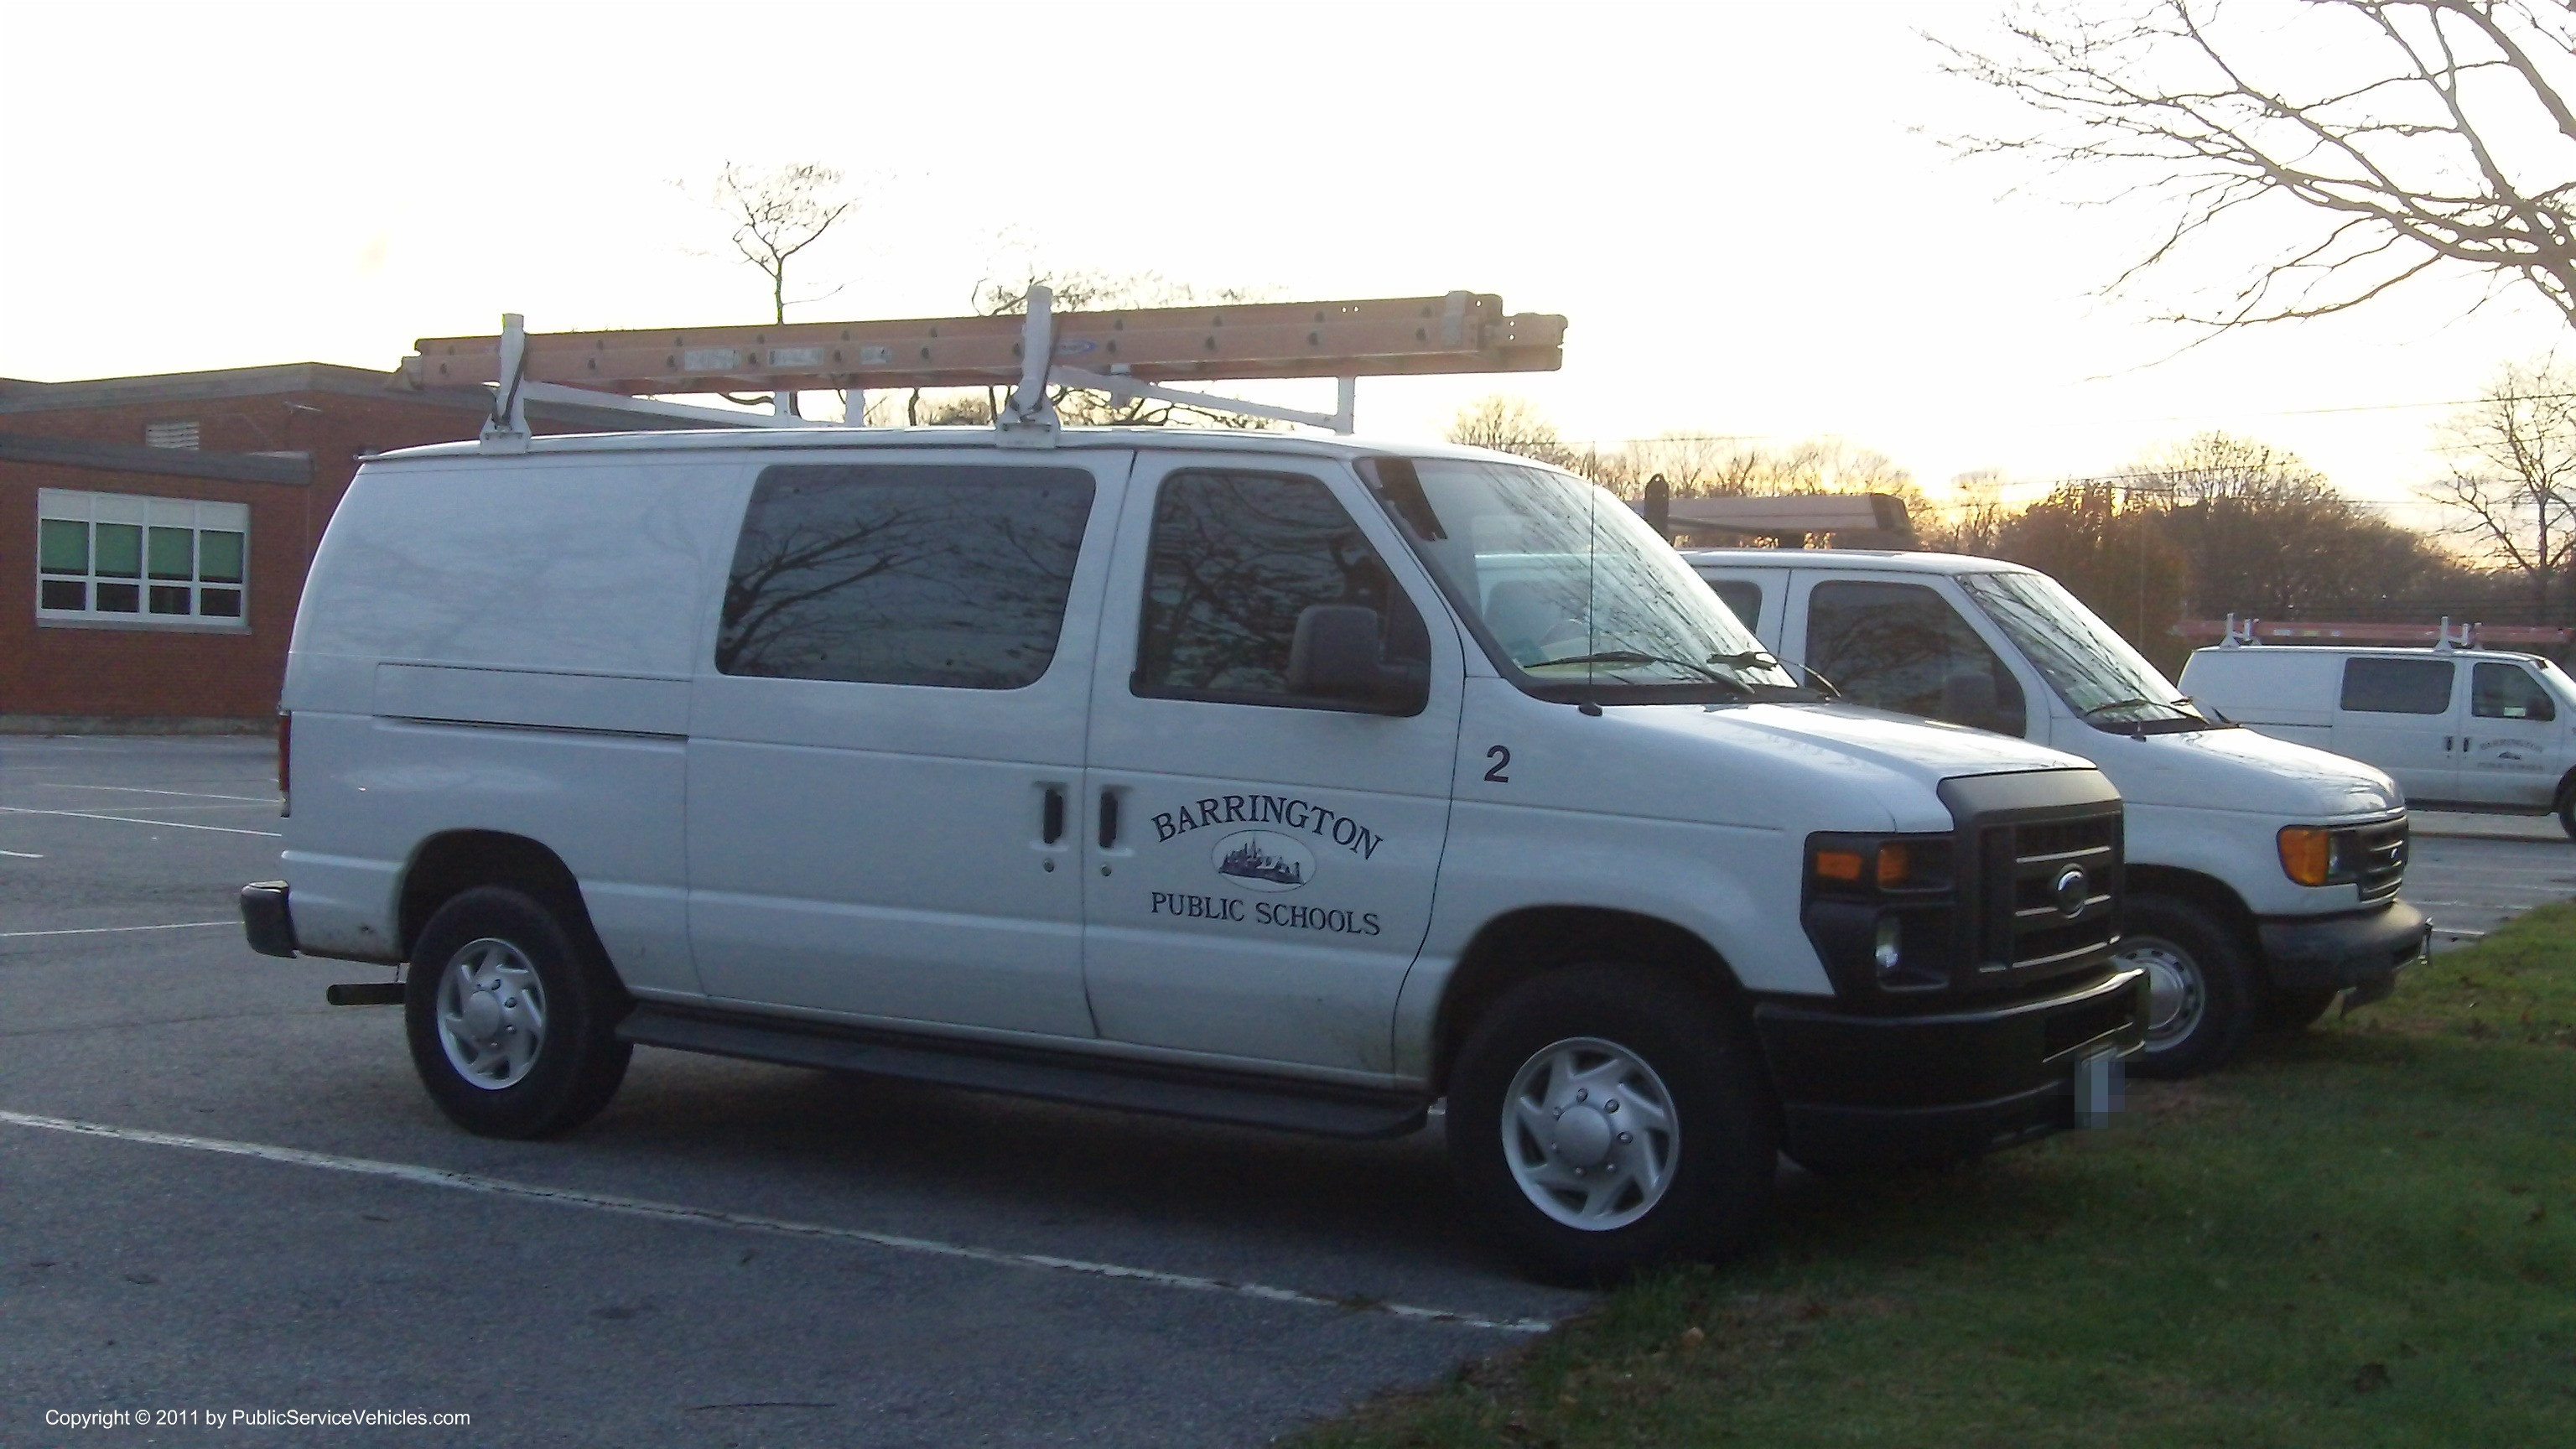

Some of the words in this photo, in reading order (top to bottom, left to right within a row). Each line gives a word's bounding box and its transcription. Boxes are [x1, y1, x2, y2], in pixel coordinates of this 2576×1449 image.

[1484, 745, 1510, 783] 2
[1150, 795, 1384, 860] BARRINGTON
[1151, 891, 1245, 922] PUBLIC
[1255, 902, 1381, 937] SCHOOLS
